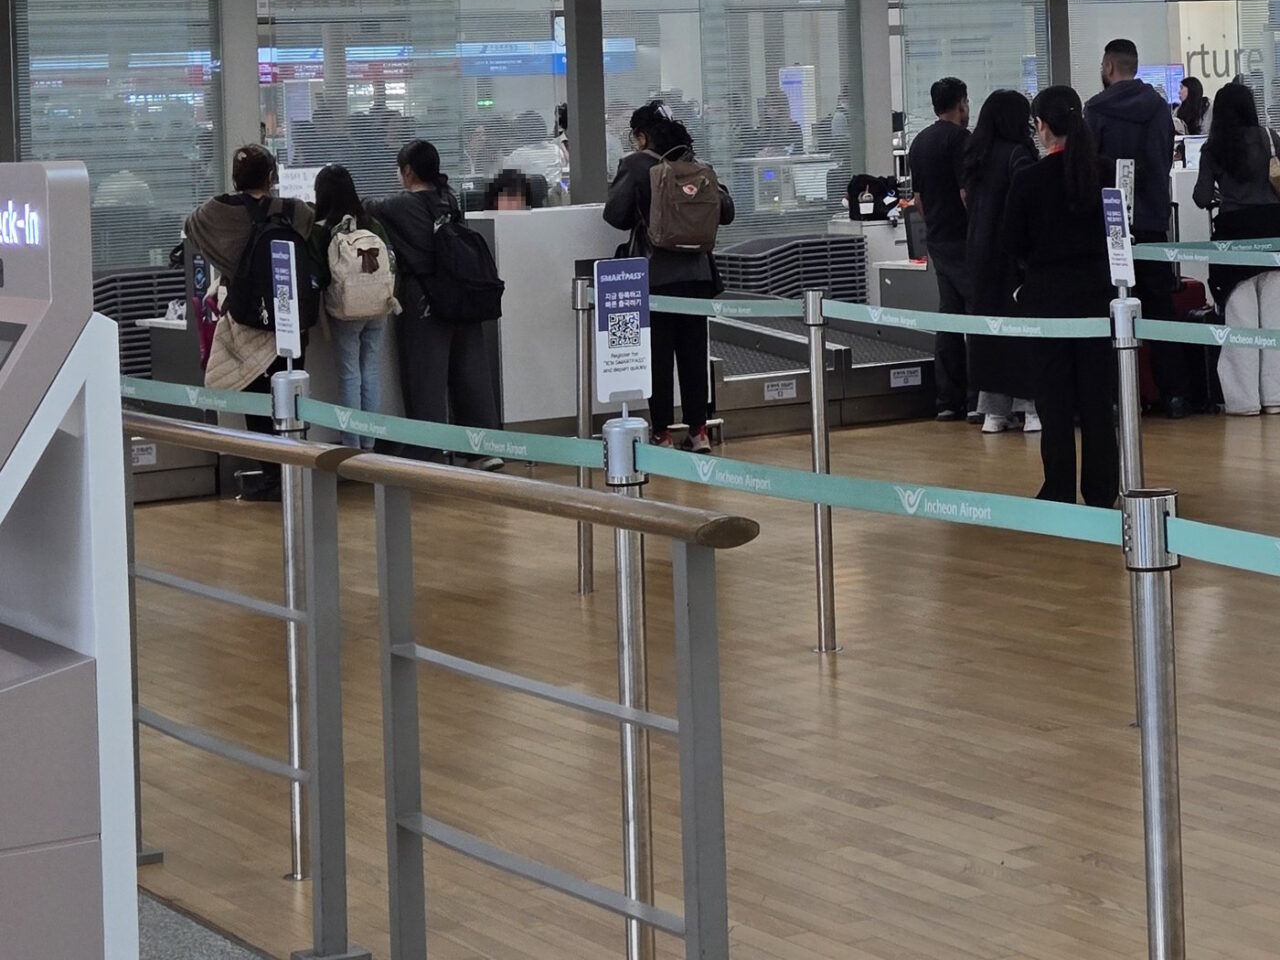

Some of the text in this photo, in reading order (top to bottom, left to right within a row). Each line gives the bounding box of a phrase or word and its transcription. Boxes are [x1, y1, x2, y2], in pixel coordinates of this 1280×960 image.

[1186, 43, 1264, 79] rture
[0, 200, 39, 245] ck-In
[1229, 334, 1277, 347] Incheon Airport
[483, 440, 527, 456] Incheon Airport
[715, 469, 771, 490] Incheon Airport
[924, 498, 992, 520] Incheon Airport
